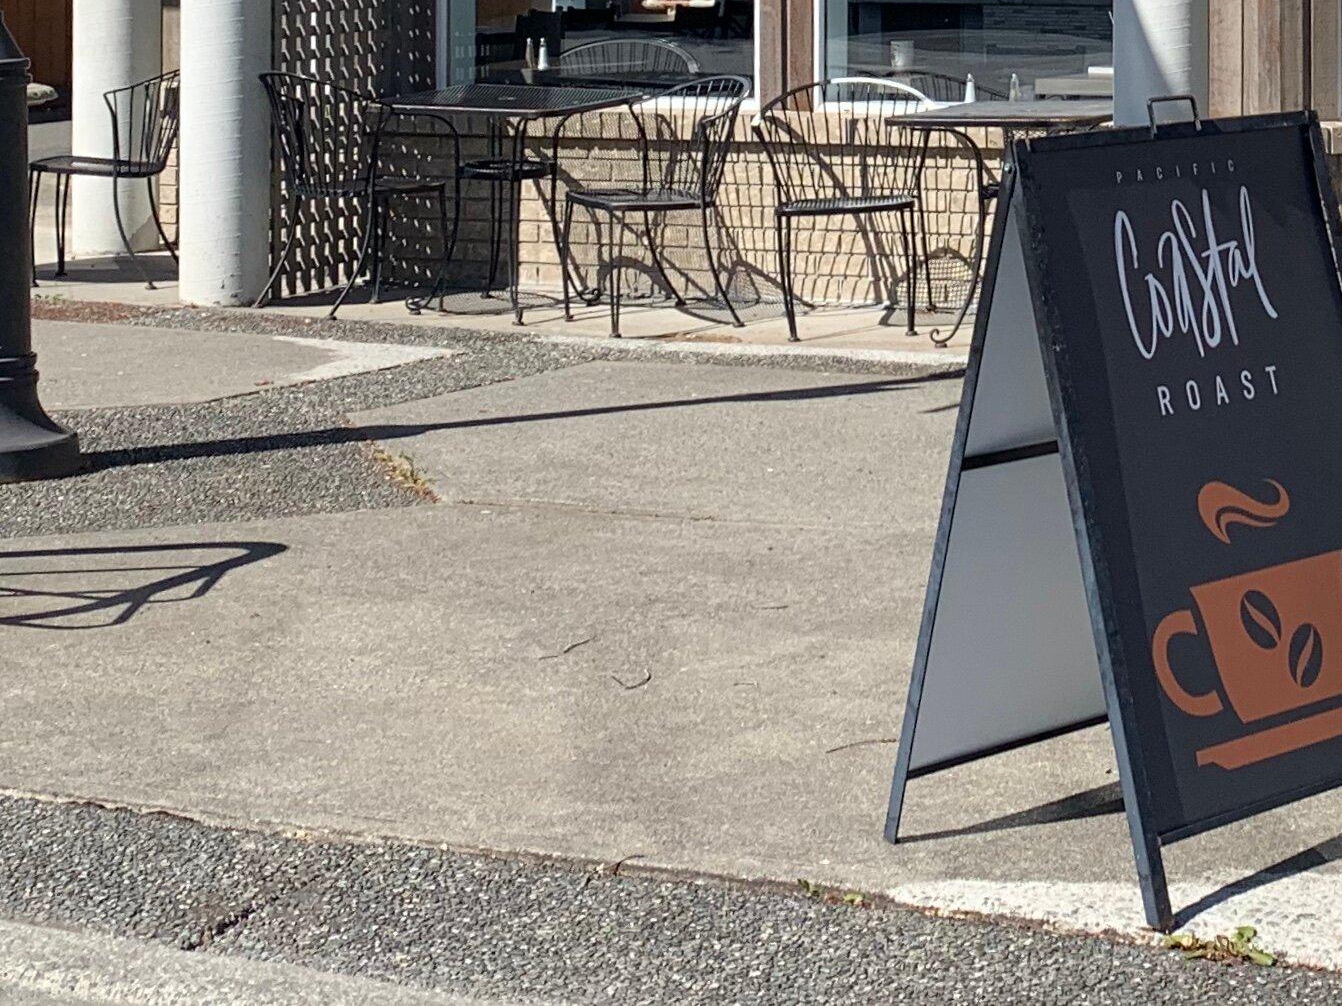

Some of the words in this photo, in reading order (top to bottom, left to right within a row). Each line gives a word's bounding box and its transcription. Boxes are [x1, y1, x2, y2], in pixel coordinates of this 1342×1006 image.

[1115, 159, 1236, 184] PACIFIC
[1114, 185, 1278, 361] Coastal
[1156, 364, 1280, 417] ROAST
